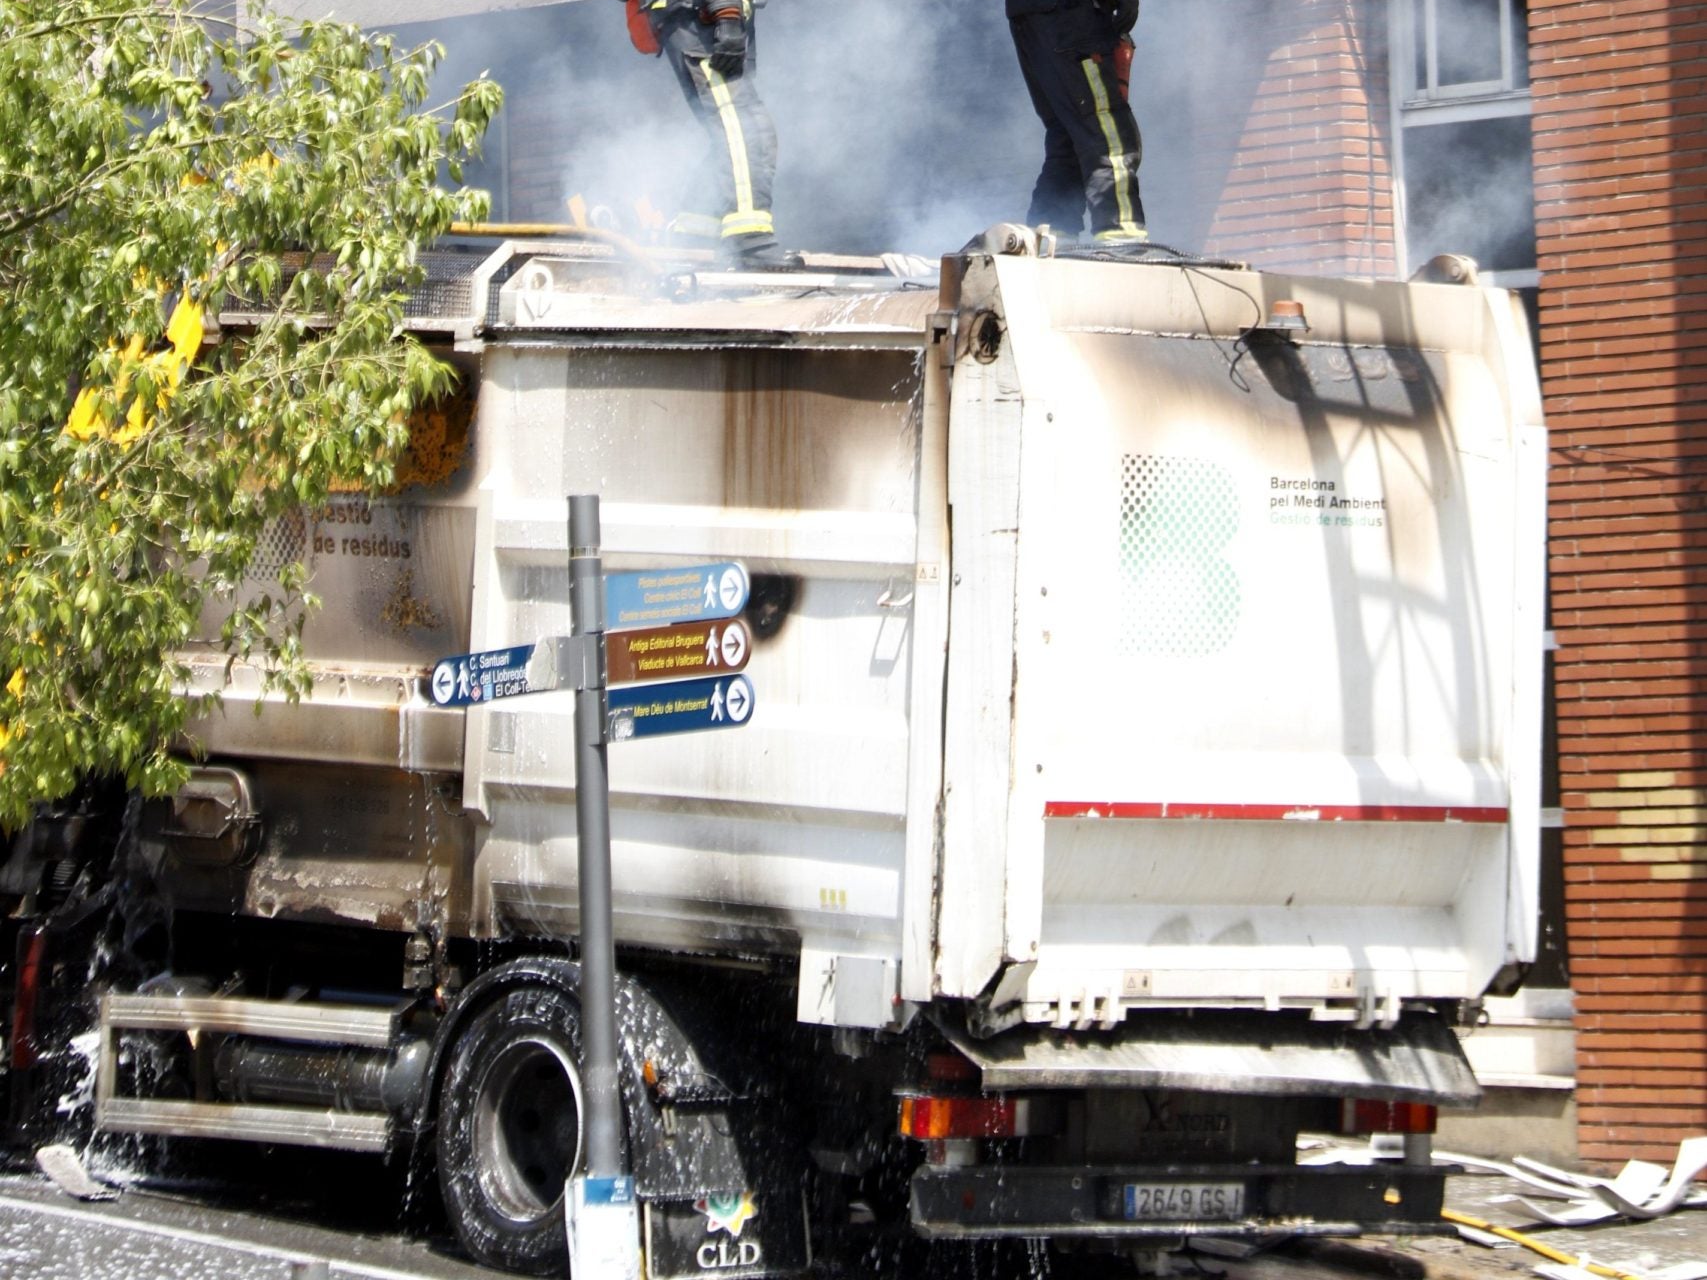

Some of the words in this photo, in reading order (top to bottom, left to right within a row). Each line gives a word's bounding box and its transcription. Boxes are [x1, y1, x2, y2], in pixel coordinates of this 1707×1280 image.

[1270, 477, 1336, 491] Barcelona
[1270, 495, 1289, 510] pel
[1293, 495, 1325, 508] Medi
[1329, 496, 1387, 510] Ambient
[1316, 513, 1330, 526] de
[1335, 514, 1383, 527] residus
[313, 532, 336, 555] de
[341, 533, 411, 559] residus
[629, 640, 649, 653] Antiga
[650, 636, 675, 650] Editorial
[675, 635, 704, 648] Bruguera
[469, 656, 478, 671] C.
[480, 651, 510, 669] Santuari
[638, 658, 665, 671] Viaducte
[666, 657, 674, 667] de
[675, 654, 704, 667] Vallcarca
[470, 673, 479, 687] C.
[480, 671, 491, 685] del
[495, 684, 503, 697] El
[634, 705, 649, 717] Mare
[651, 702, 664, 715] Déu
[665, 702, 673, 713] de
[674, 698, 708, 712] Montserrat
[1140, 1188, 1192, 1215] 2649
[696, 1242, 761, 1269] CLD
